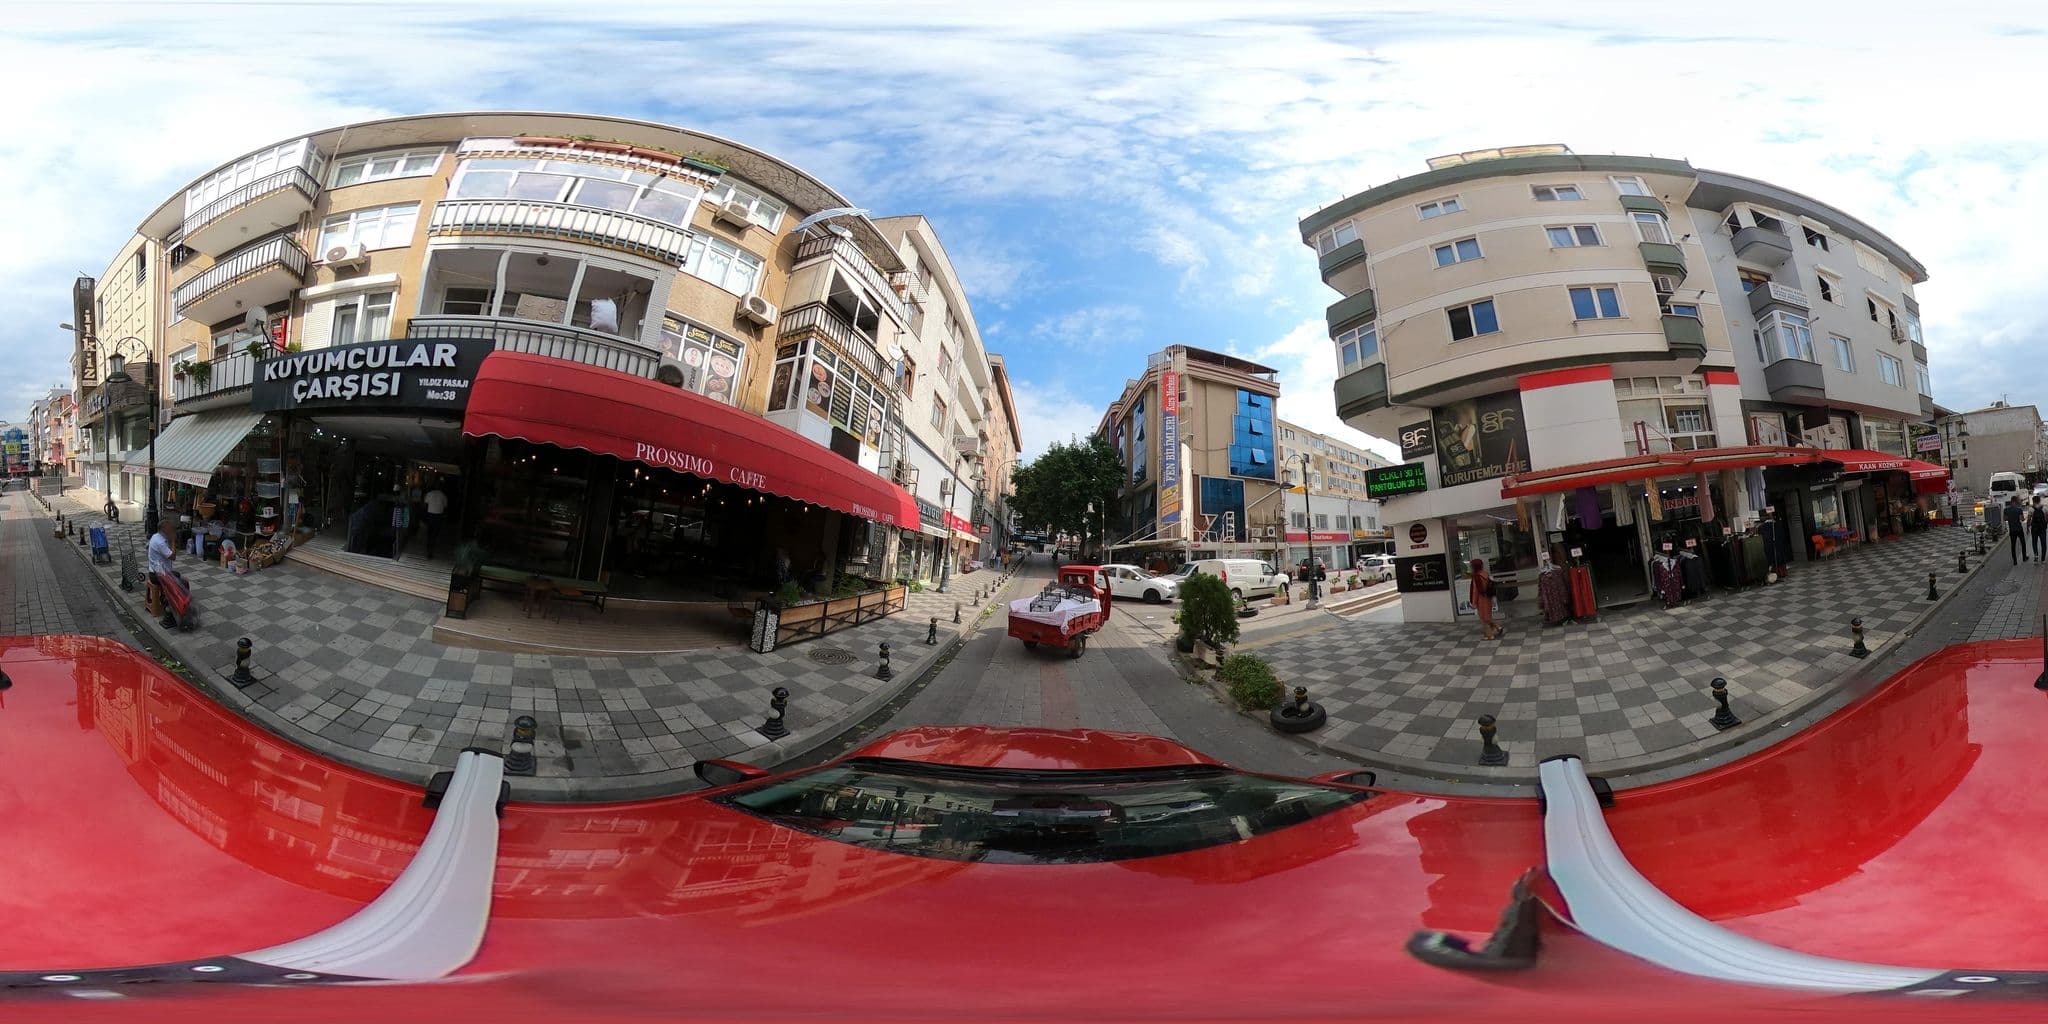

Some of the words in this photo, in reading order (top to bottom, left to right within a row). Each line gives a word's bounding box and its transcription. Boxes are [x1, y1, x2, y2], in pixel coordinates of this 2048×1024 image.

[264, 343, 457, 381] KUYUMCULAR
[293, 372, 401, 403] ÇARŞISI
[419, 378, 441, 388] YILDIZ
[442, 379, 469, 389] PASAJI
[426, 390, 456, 401] No:38
[636, 442, 713, 475] PROSSIMO
[730, 467, 766, 489] CAFFE
[1165, 463, 1176, 481] FEN
